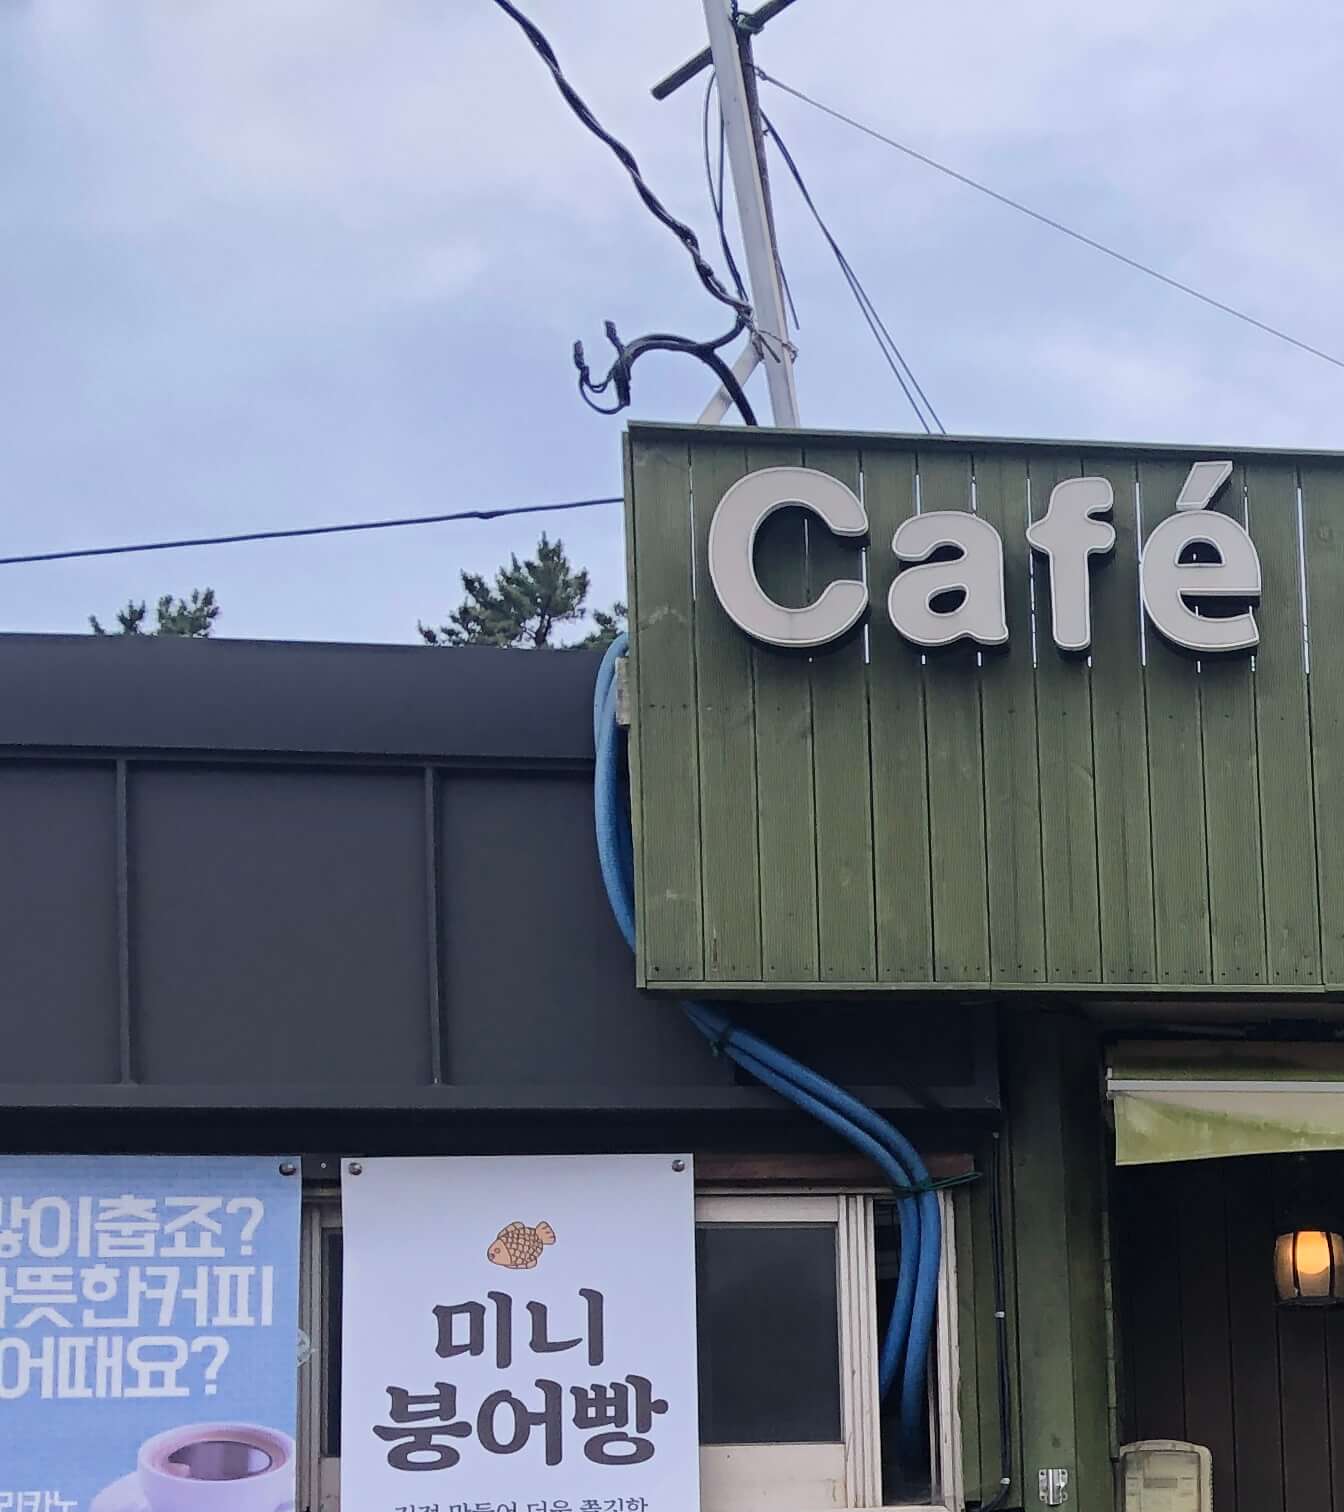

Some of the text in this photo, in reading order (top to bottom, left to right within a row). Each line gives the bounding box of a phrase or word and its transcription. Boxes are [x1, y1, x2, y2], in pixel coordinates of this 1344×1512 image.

[708, 461, 1261, 653] Café
[0, 1335, 231, 1399] 어때요?
[432, 1288, 604, 1369] 미니
[372, 1374, 669, 1471] 붕어빵
